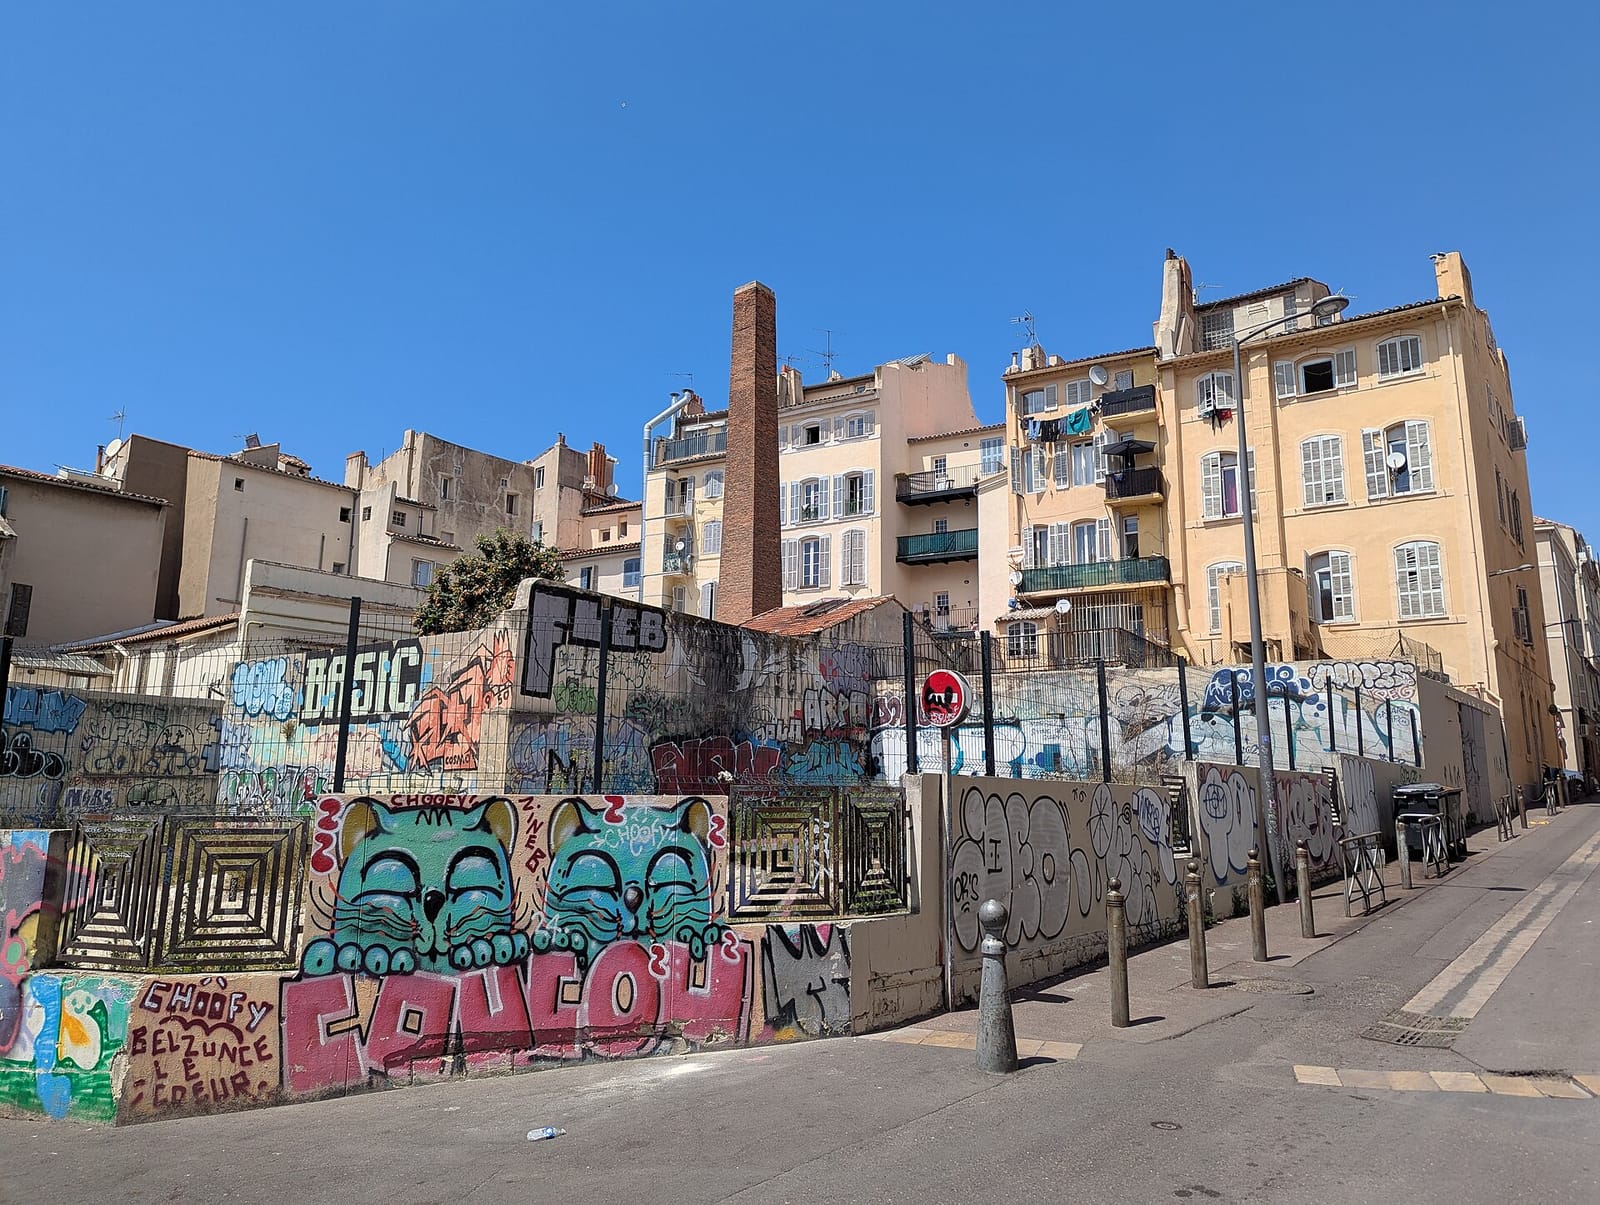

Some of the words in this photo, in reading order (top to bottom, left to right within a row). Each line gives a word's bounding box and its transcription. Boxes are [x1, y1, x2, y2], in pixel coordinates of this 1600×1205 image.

[301, 640, 423, 721] BASIC
[131, 1026, 273, 1068] BELZUNCE
[154, 1058, 200, 1082] LE
